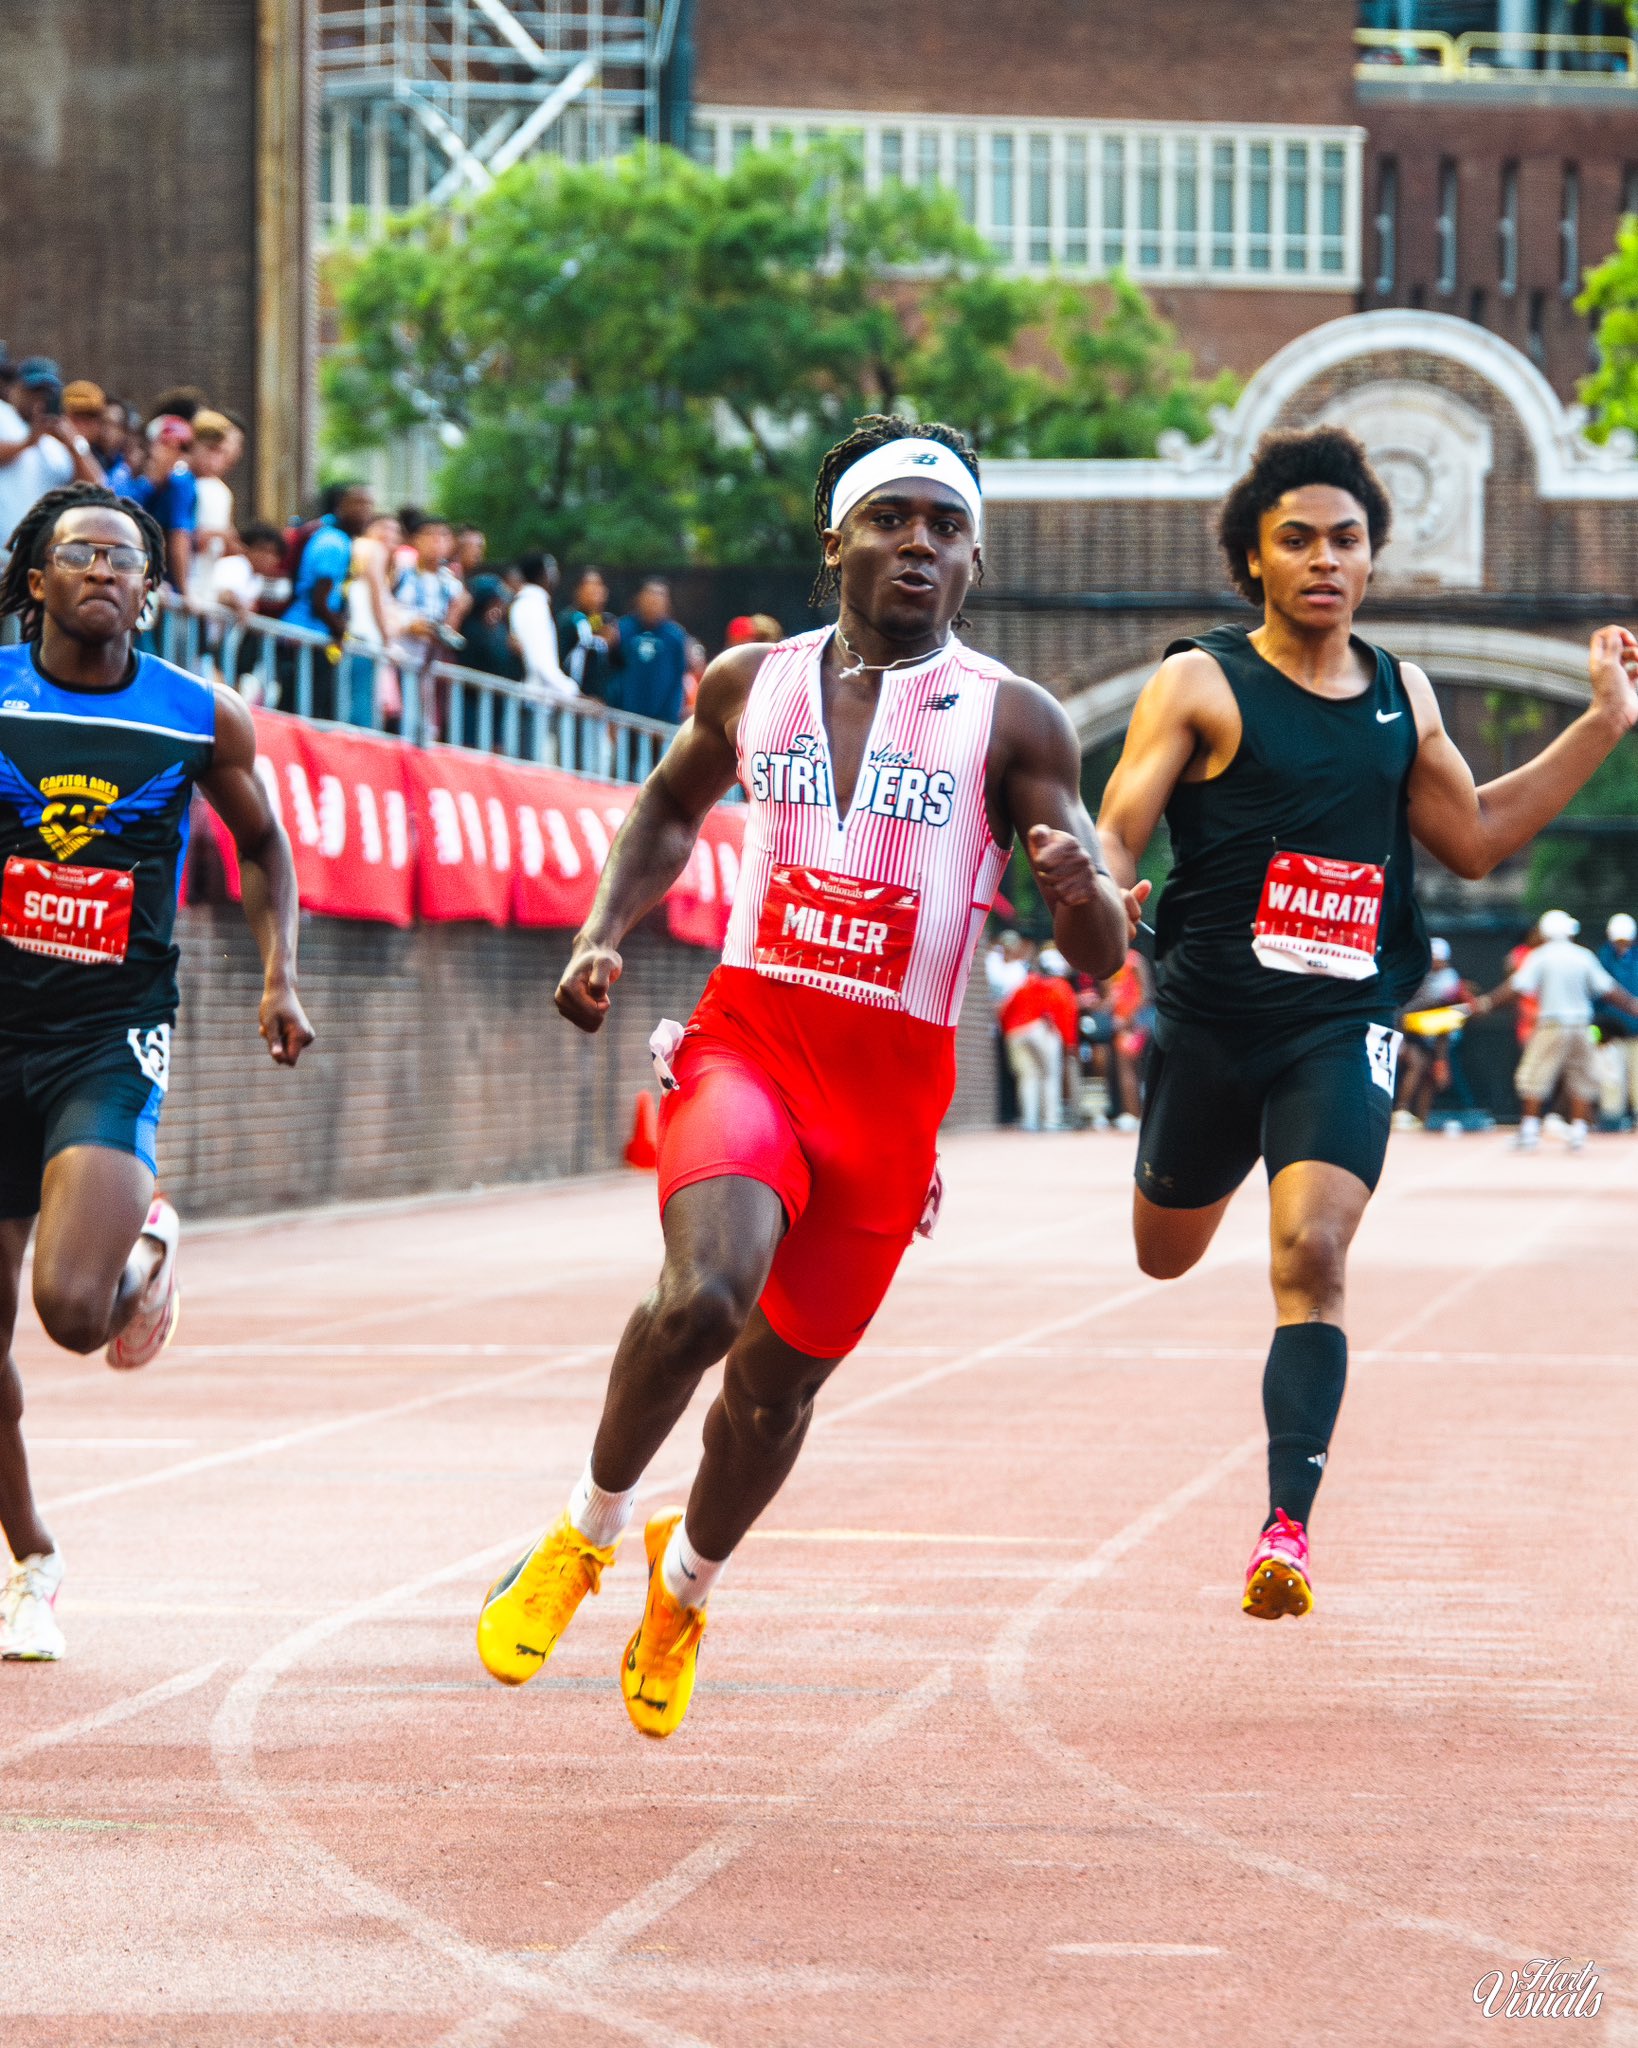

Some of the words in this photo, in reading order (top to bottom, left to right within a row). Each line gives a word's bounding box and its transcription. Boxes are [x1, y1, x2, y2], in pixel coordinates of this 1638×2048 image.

[40, 774, 87, 791] CAPITOL
[89, 776, 119, 799] AREA
[23, 890, 110, 930] SCOTT
[1267, 881, 1379, 926] WALRATH
[781, 902, 889, 956] MILLER
